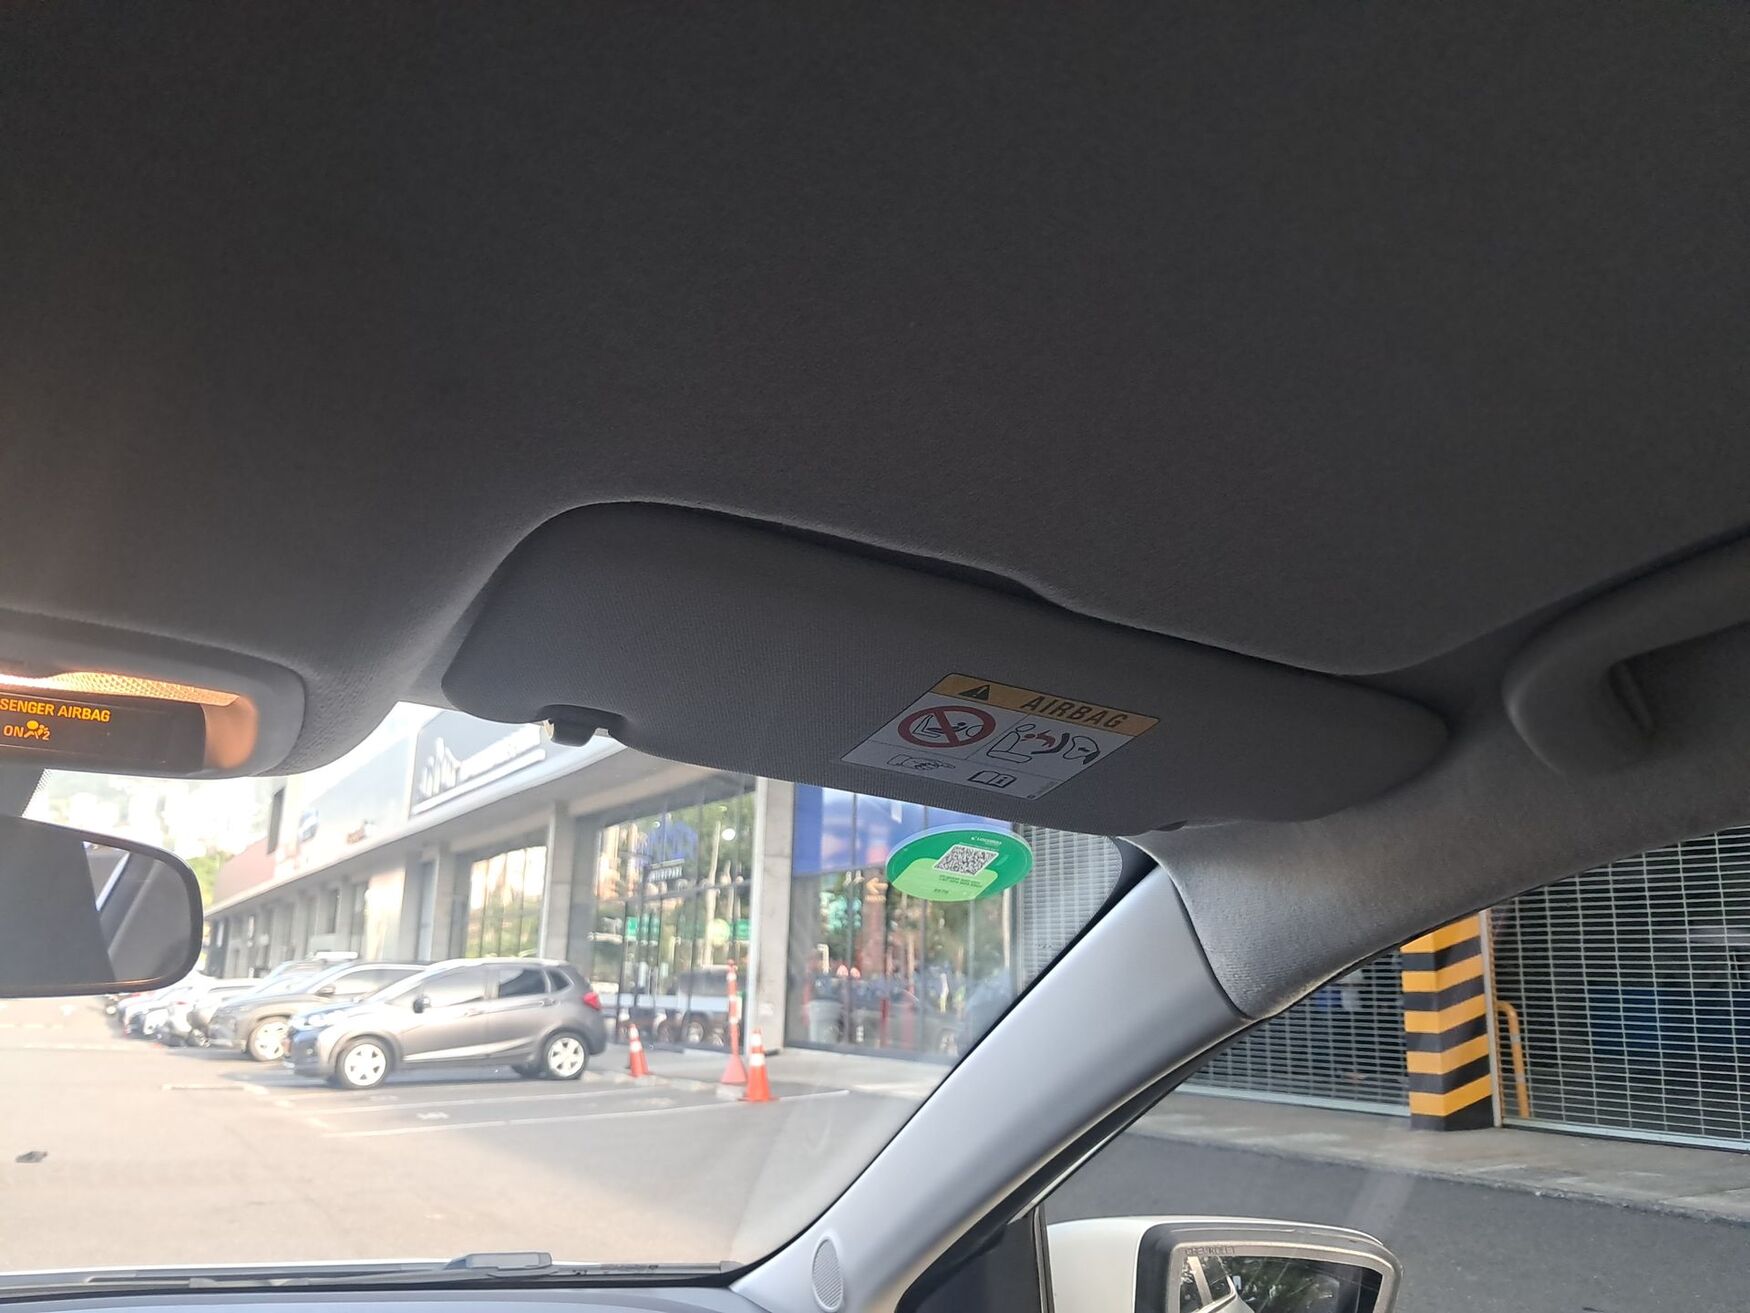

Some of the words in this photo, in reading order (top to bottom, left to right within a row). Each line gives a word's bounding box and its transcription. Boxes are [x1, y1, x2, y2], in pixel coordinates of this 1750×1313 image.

[57, 705, 111, 722] AIRBAG
[1020, 696, 1128, 728] AIRBAG
[3, 724, 24, 738] ON
